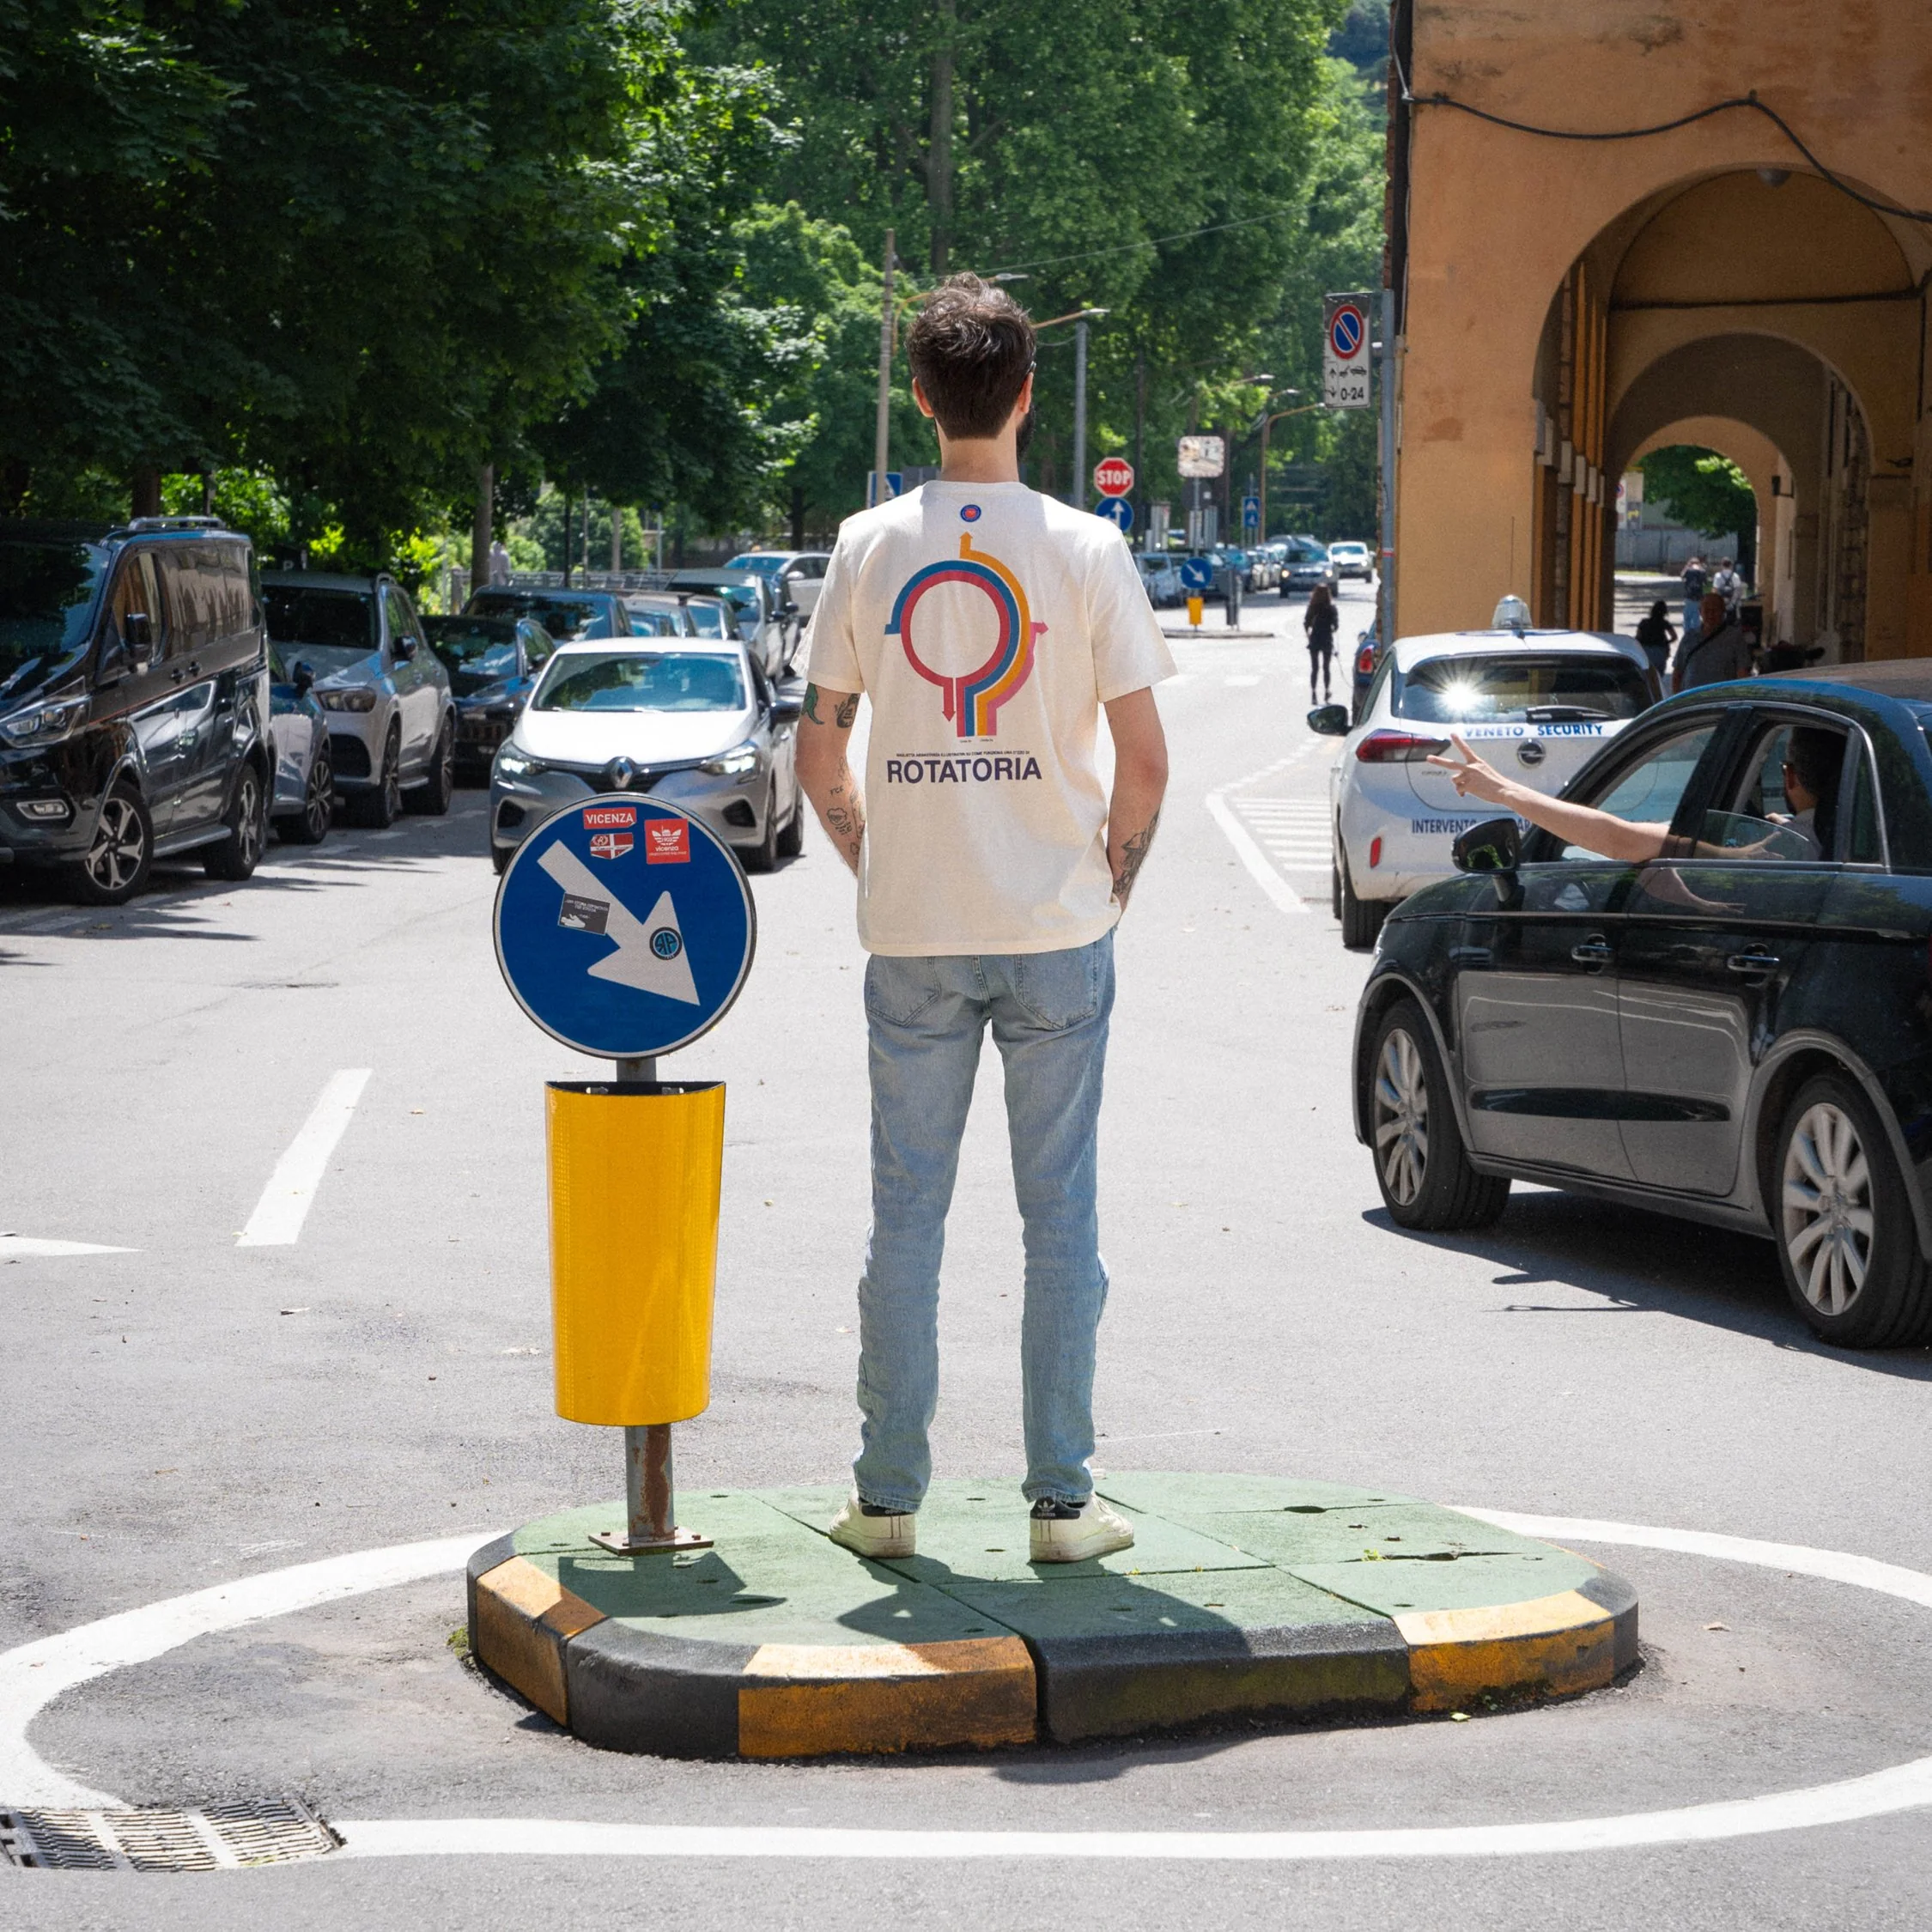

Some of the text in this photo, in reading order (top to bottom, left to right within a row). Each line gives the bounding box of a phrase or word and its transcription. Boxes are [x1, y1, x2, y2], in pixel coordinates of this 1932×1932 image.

[1340, 386, 1364, 401] 0-24
[1097, 470, 1131, 485] STOP
[1466, 723, 1603, 738] VENETO SECURITY
[886, 757, 1042, 783] ROTATORIA
[585, 812, 634, 824] VICENZA
